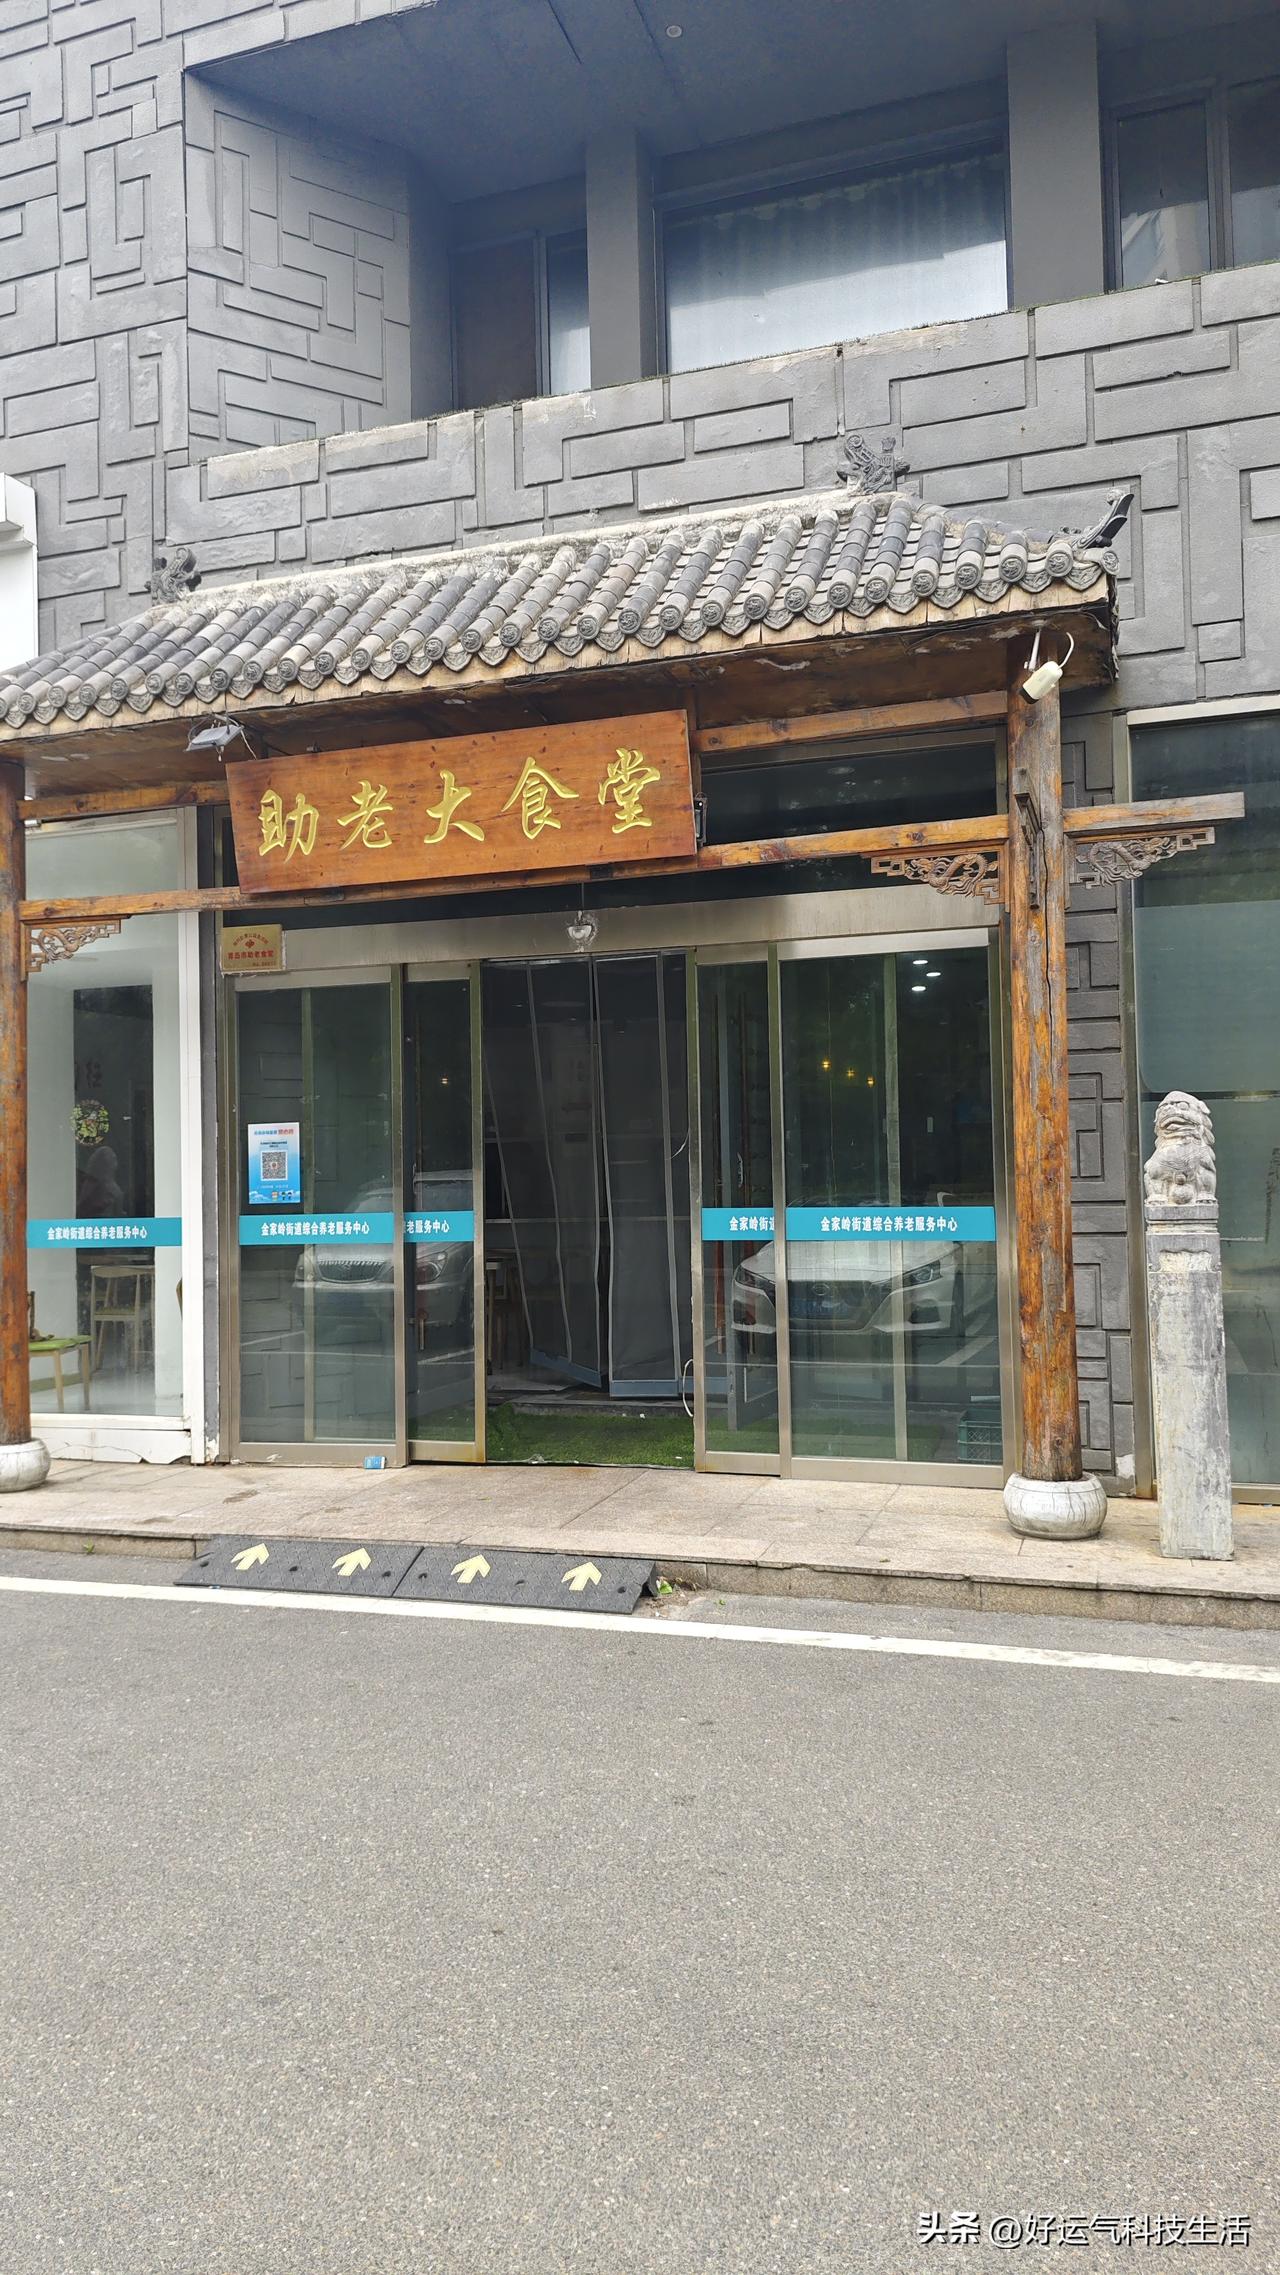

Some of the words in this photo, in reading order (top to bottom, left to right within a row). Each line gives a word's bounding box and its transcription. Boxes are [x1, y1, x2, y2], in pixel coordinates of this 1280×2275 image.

[259, 747, 661, 864] 助老大食堂
[261, 1220, 370, 1236] 金家岭街道综合养老服务中心
[820, 1215, 958, 1232] 金家岭街道综合养老服务中心
[47, 1225, 148, 1240] 金家岭街道综合养老服务中心
